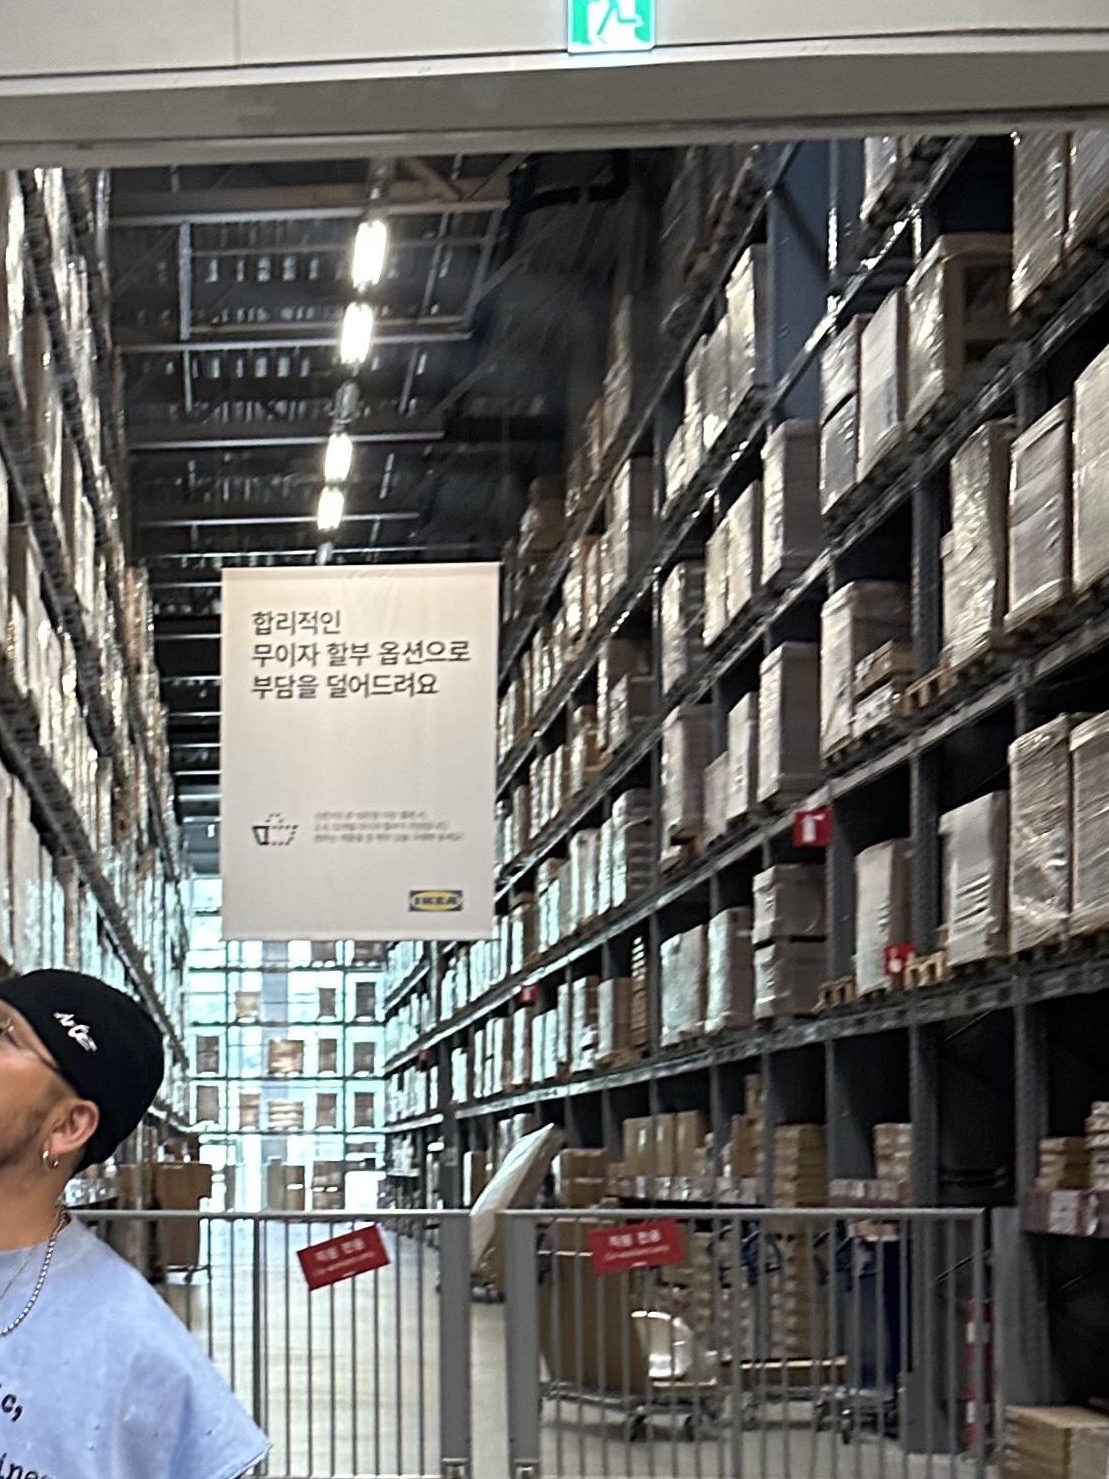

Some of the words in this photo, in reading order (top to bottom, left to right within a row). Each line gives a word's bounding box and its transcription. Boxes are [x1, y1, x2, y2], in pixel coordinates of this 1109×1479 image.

[252, 609, 341, 636] 합리적인
[251, 642, 320, 668] 무이자
[326, 641, 371, 667] 할부
[378, 640, 471, 666] 옵션으로
[251, 673, 320, 700] 부담을
[327, 672, 440, 699] 덜어드려요
